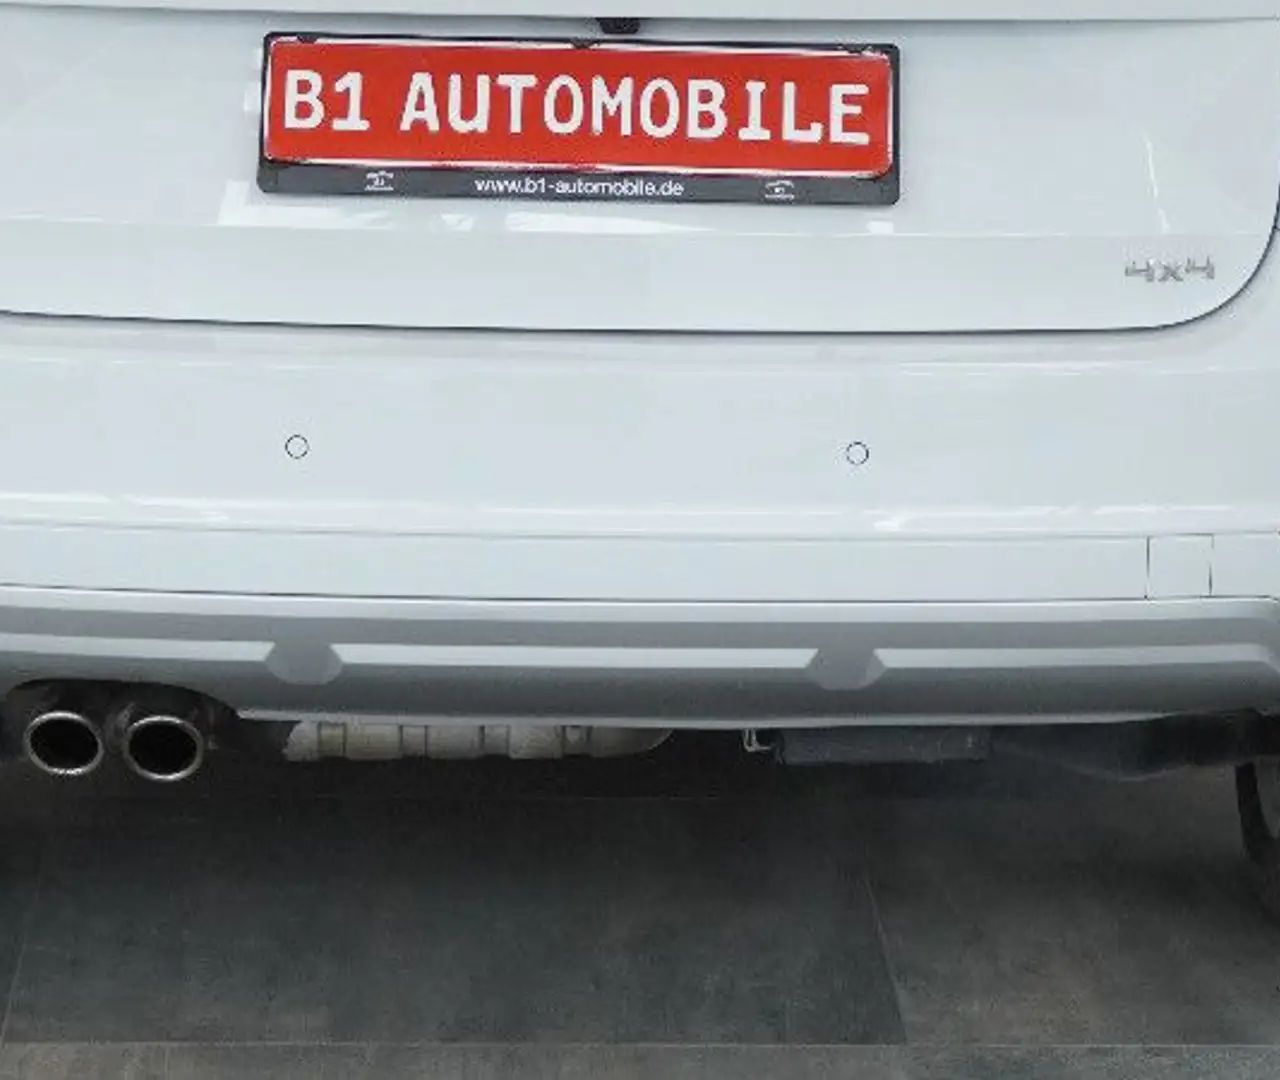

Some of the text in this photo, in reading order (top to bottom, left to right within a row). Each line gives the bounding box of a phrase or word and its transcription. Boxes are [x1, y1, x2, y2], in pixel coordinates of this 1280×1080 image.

[283, 69, 871, 146] B1 AUTOMOBILE
[474, 177, 684, 197] www.b1-automobile.de
